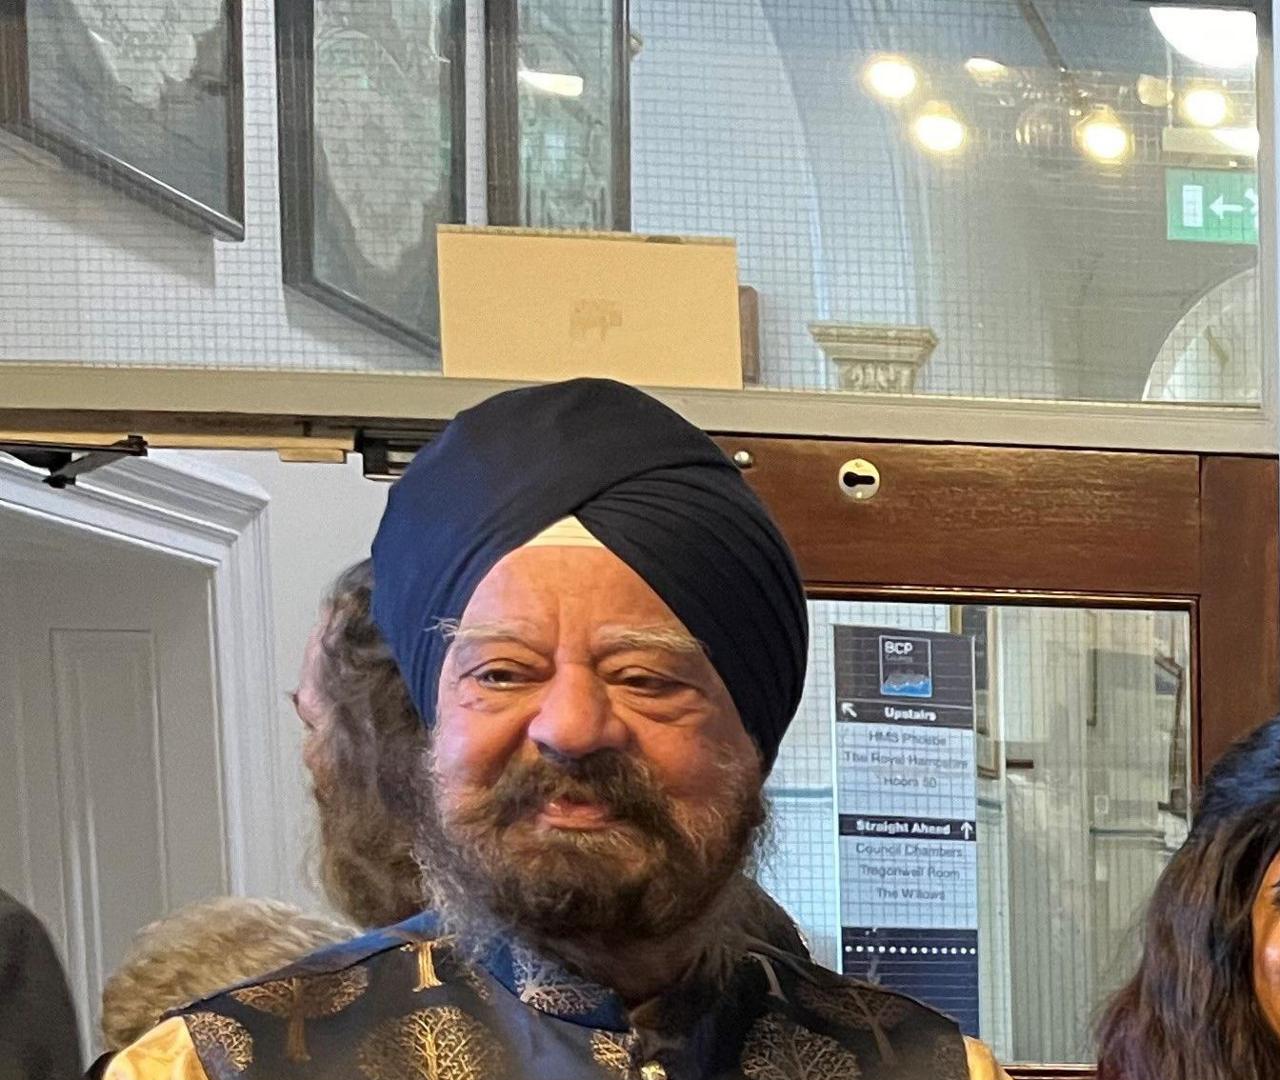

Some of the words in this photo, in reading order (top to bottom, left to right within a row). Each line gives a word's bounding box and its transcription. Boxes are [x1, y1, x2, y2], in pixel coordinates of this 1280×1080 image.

[884, 640, 914, 655] BCP
[884, 706, 937, 722] Upstairs
[856, 819, 909, 835] Straight
[911, 822, 951, 836] Ahead
[855, 842, 901, 857] Council
[903, 843, 963, 858] Chambers
[927, 866, 960, 881] Room
[876, 886, 899, 899] The
